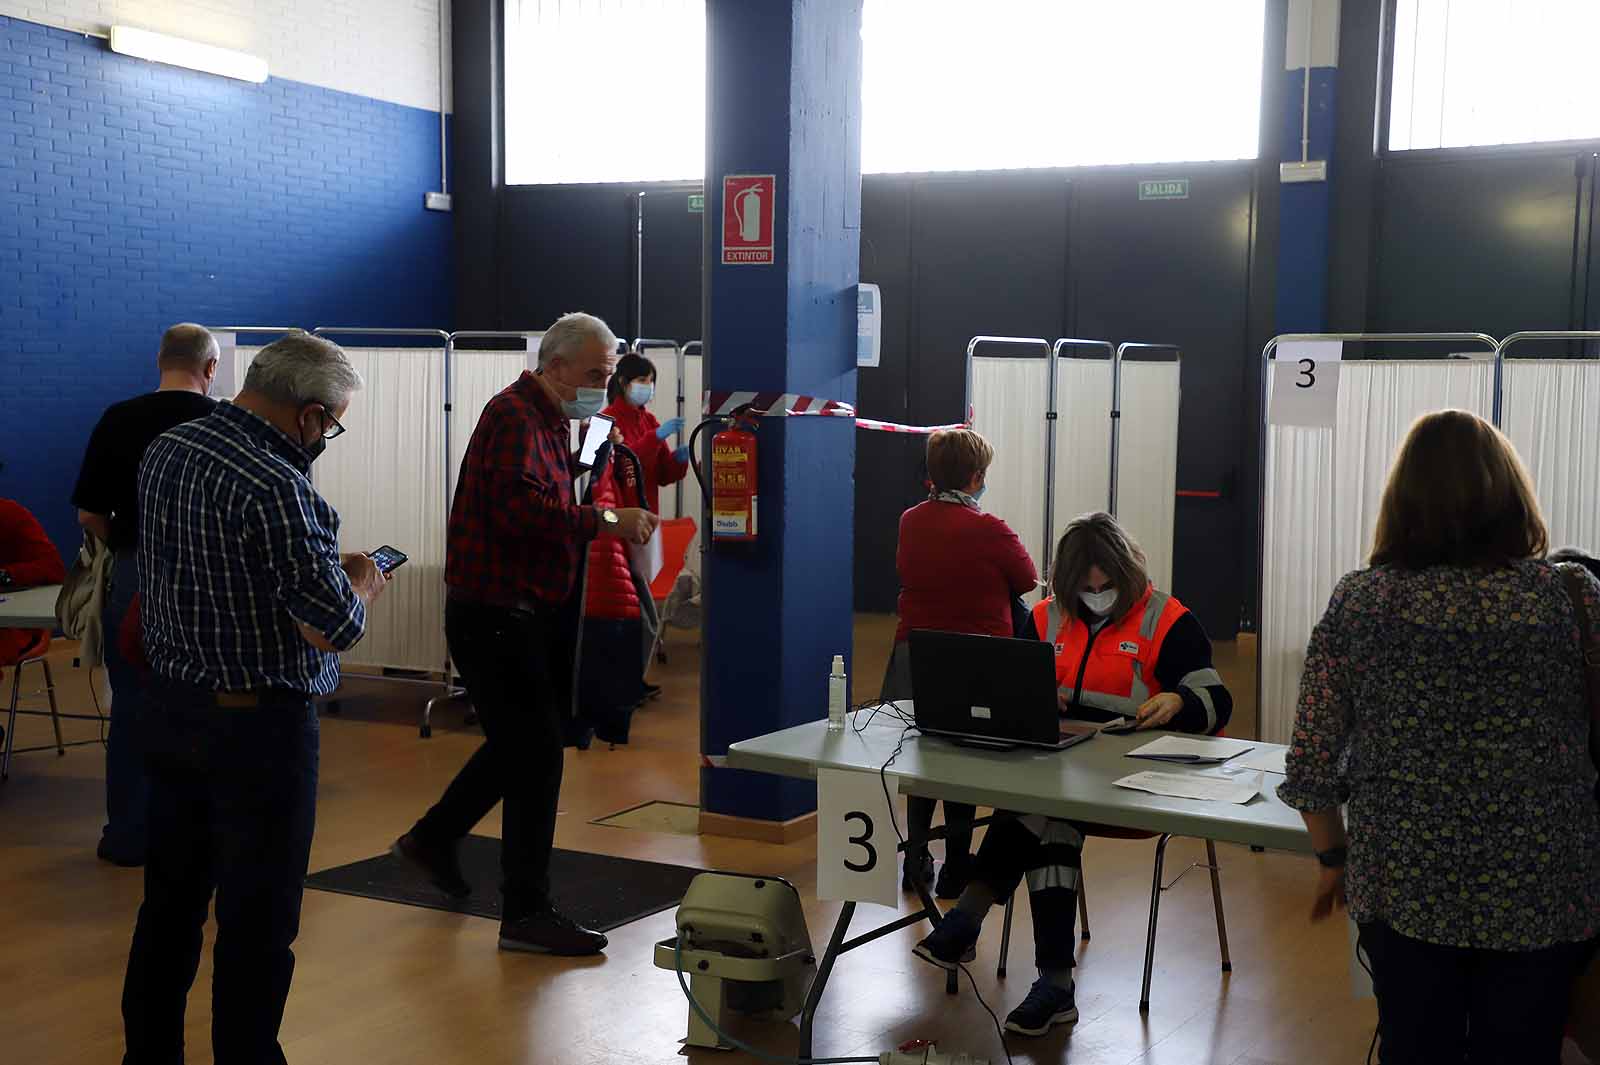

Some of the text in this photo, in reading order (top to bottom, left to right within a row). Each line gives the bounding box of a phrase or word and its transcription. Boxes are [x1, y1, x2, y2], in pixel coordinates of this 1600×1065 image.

[1144, 183, 1185, 195] SALIDA
[727, 251, 768, 261] EXTINTOR
[1296, 358, 1316, 388] 3
[843, 811, 878, 873] 3
